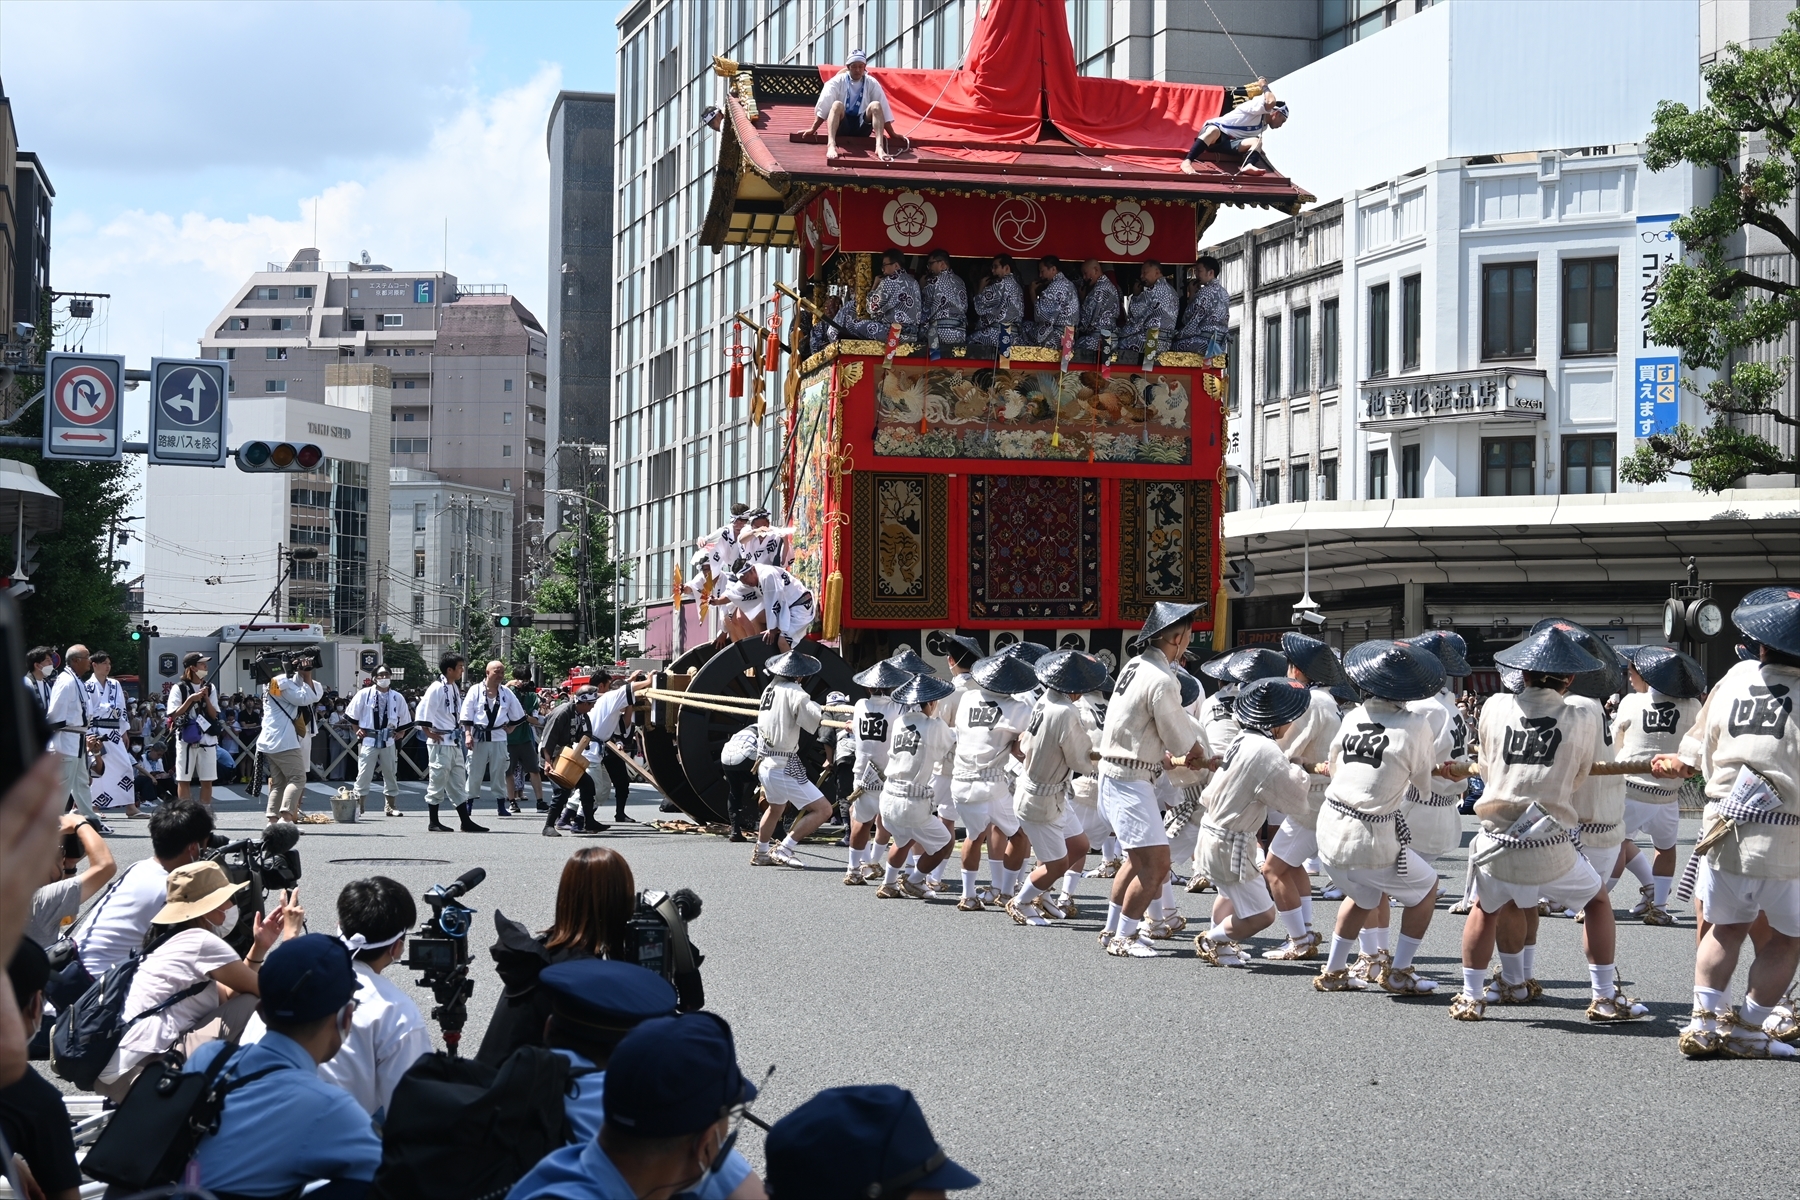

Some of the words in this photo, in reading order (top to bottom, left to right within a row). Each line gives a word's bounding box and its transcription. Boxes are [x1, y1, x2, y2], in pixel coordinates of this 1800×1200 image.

[1365, 381, 1497, 418] 池善化粧品店
[1639, 364, 1656, 435] 買えます
[1657, 365, 1674, 402] すぐ
[157, 434, 218, 450] 路線バスを除く
